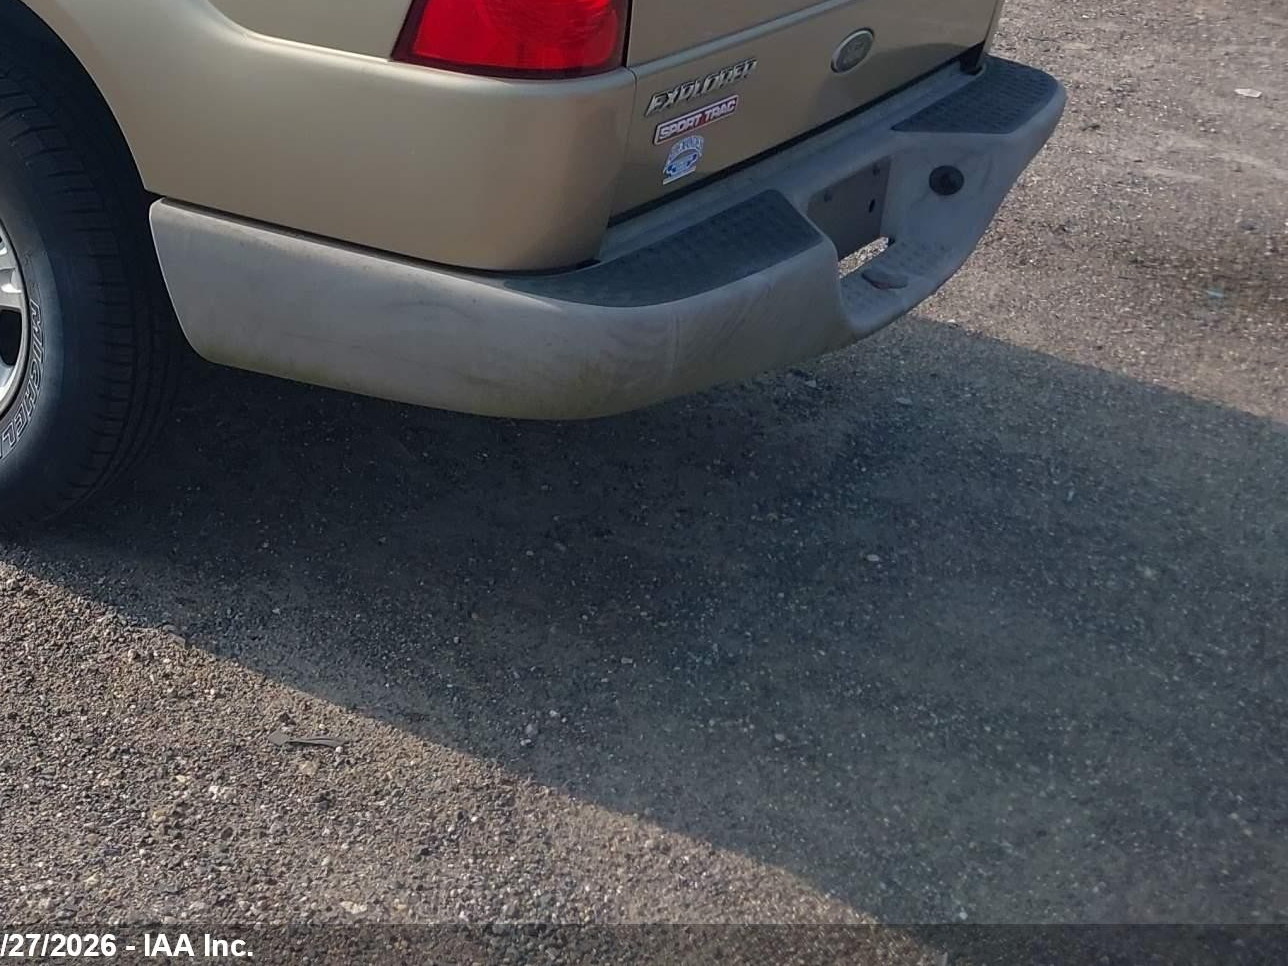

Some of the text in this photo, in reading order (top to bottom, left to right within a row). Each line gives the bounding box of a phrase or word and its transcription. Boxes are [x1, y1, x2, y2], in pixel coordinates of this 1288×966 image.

[645, 56, 758, 116] EXPLORER
[658, 99, 737, 140] SPORT TRAC
